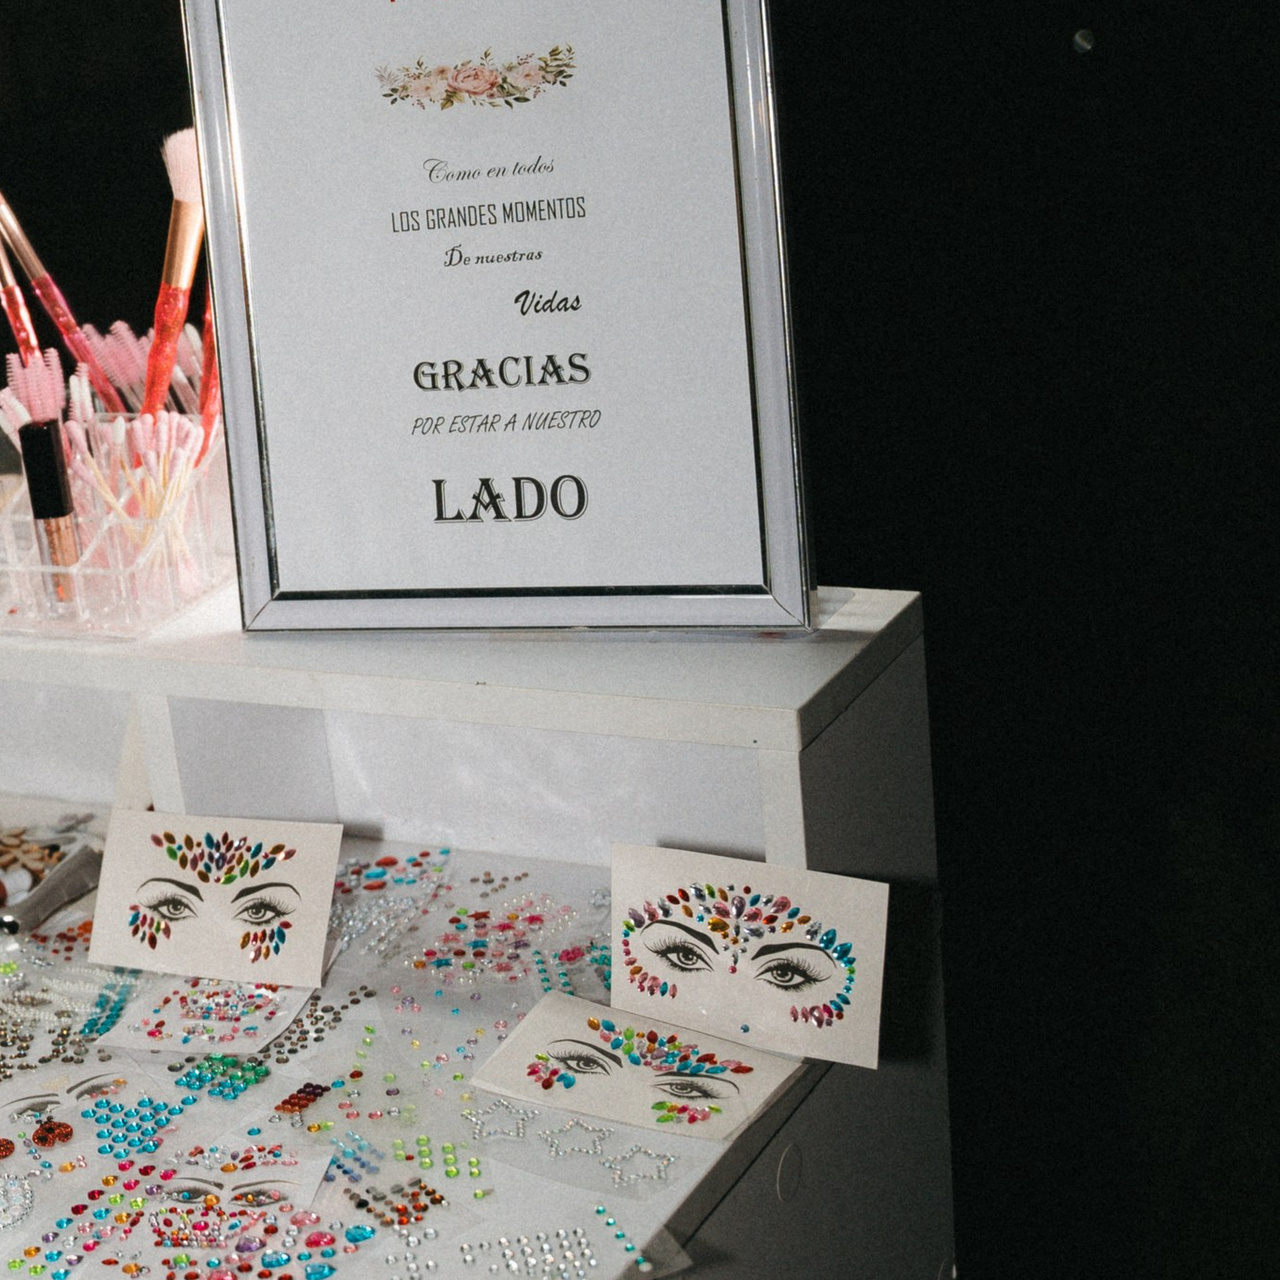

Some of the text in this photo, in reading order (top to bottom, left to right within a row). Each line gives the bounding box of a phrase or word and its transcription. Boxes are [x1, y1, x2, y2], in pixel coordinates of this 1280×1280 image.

[422, 155, 556, 183] Como en todos
[391, 196, 586, 232] LOS GRANDES MOMENTOS
[443, 243, 544, 268] De nuestras
[514, 289, 582, 316] Vidas
[413, 353, 591, 392] GRACIAS
[412, 409, 602, 435] POR ESTAR A NUESTRO
[431, 474, 588, 523] LADO
